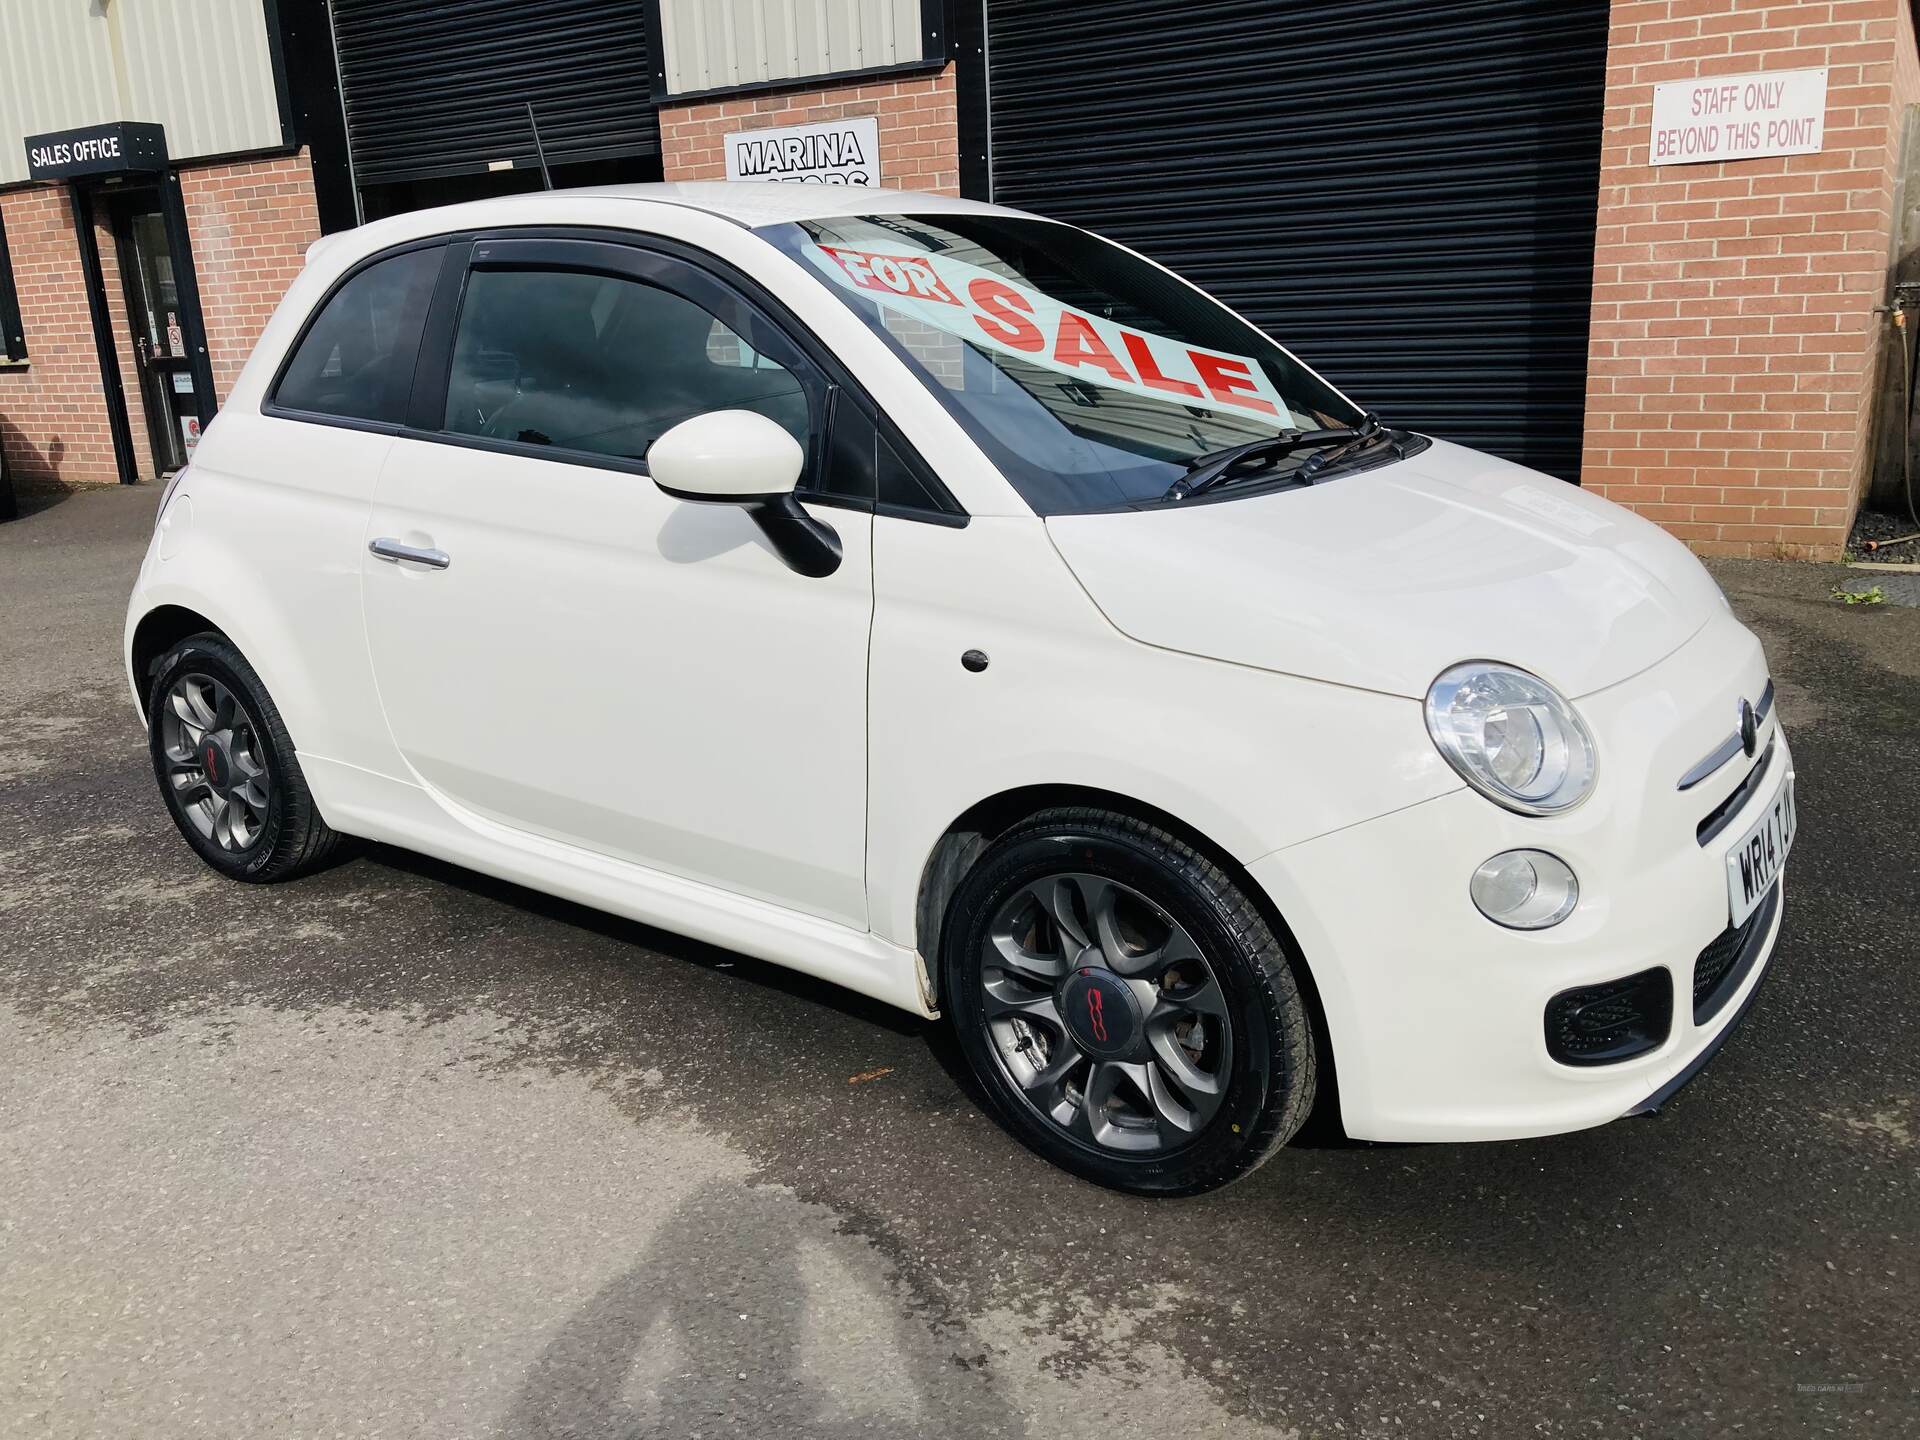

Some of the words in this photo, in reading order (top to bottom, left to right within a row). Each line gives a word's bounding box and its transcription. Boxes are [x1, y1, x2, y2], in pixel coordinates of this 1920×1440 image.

[1692, 85, 1739, 116] STAFF
[1744, 81, 1785, 112] ONLY
[31, 143, 71, 168] SALES
[73, 137, 121, 162] OFFICE
[737, 131, 865, 176] MARINA
[1656, 125, 1719, 157] BEYOND
[1726, 121, 1760, 151] THIS
[1767, 117, 1816, 148] POINT
[836, 251, 951, 304] FOR
[967, 278, 1280, 417] SALE
[1739, 818, 1775, 905] WR14
